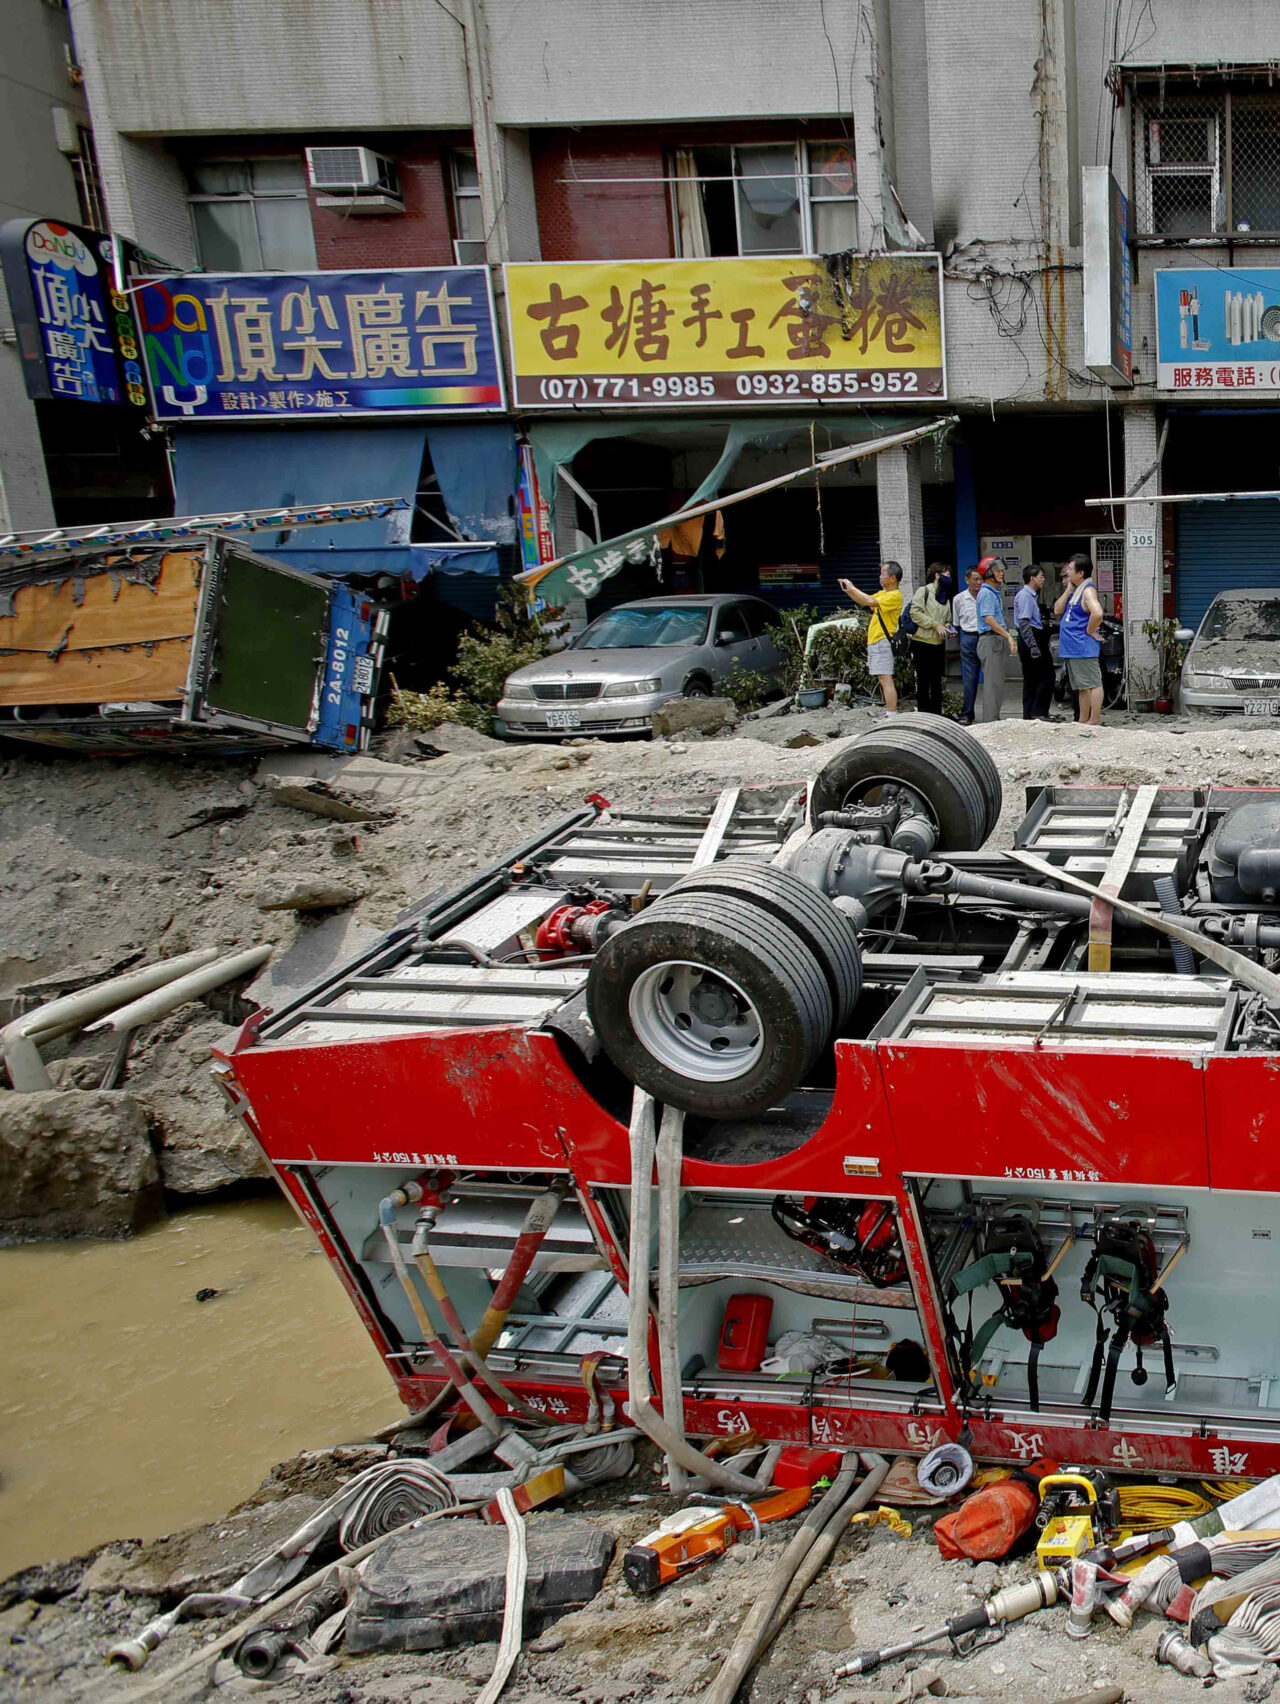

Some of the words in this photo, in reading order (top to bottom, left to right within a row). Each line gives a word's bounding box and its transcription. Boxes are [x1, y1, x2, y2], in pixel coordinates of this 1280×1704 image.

[736, 371, 919, 396] 0932-855-952
[1132, 535, 1153, 546] 305
[328, 627, 349, 705] 2A-8012
